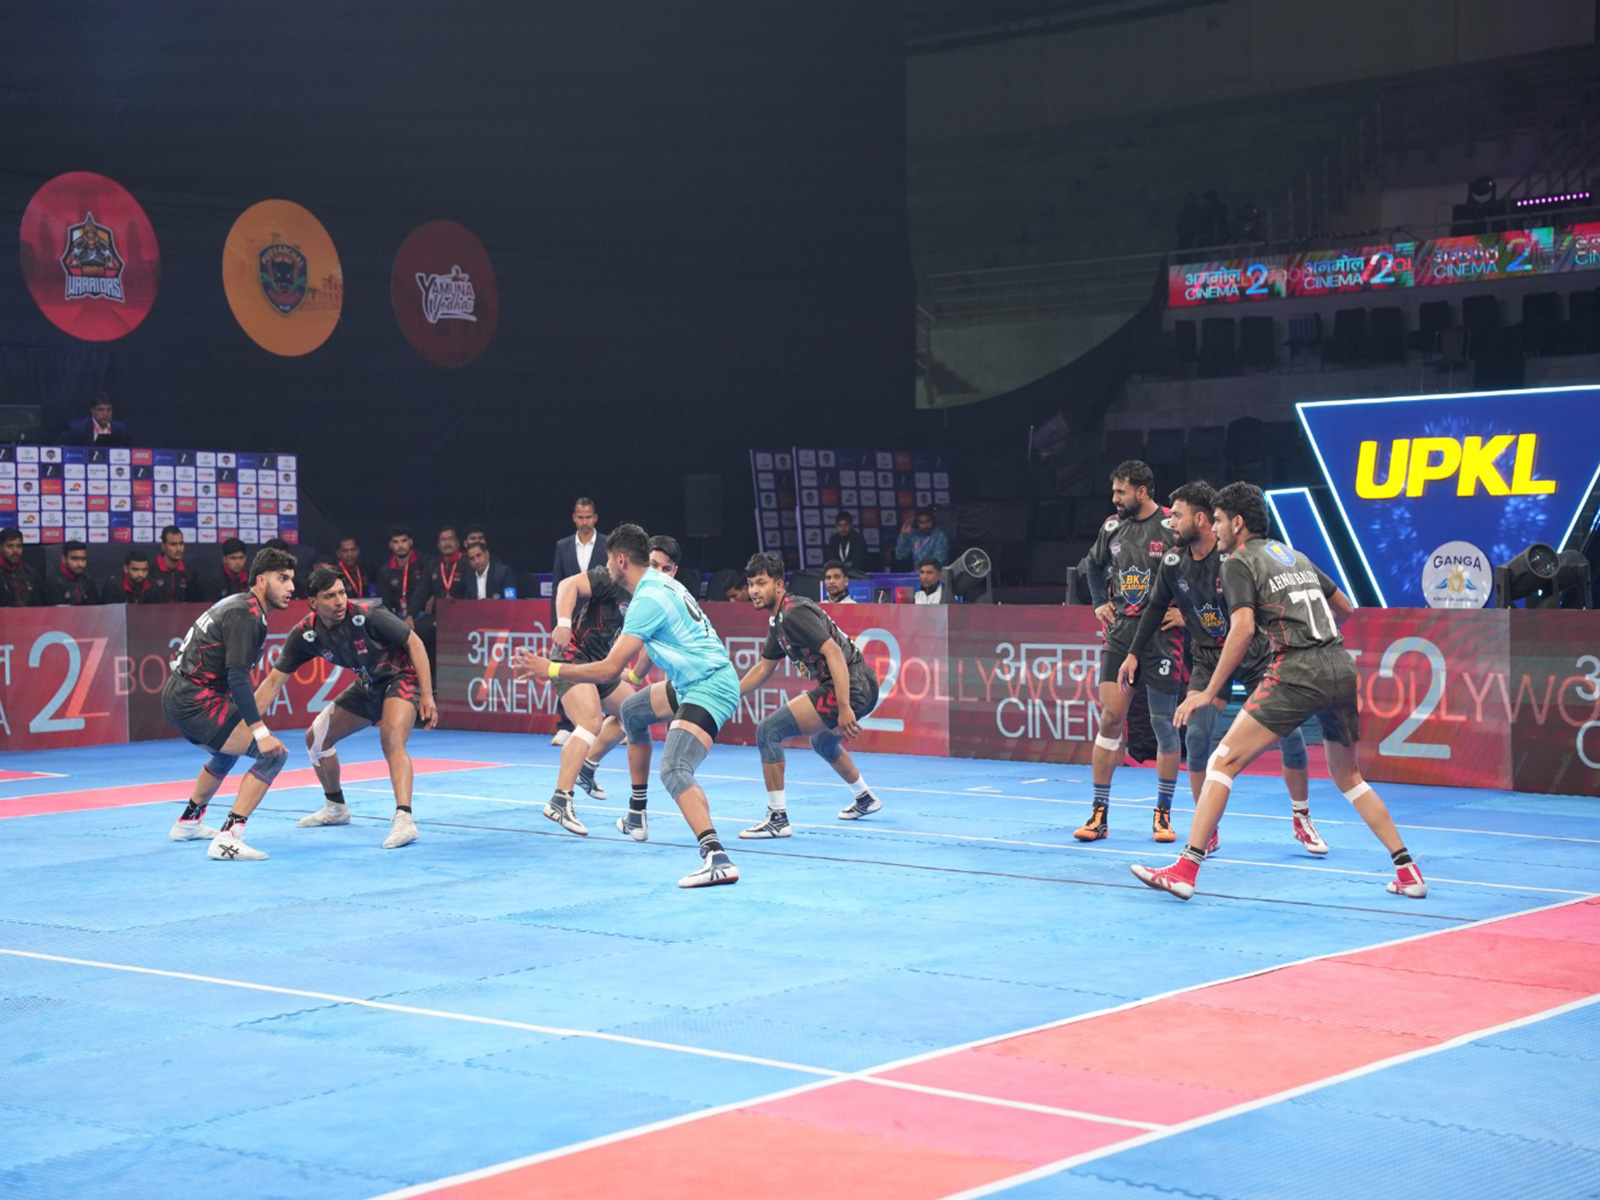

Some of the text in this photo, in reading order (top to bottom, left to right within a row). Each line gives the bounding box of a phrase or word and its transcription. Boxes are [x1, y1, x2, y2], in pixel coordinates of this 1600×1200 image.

[1304, 250, 1395, 284] अनमोल 2
[1506, 238, 1532, 272] 2
[1246, 264, 1268, 295] 2
[1304, 272, 1363, 290] CINEMA
[1434, 261, 1498, 279] CINEMA
[68, 275, 122, 298] WARRIORS
[416, 273, 475, 300] YAMUNA
[1185, 284, 1239, 300] CINEMA
[1355, 433, 1557, 499] UPKL
[1433, 555, 1482, 572] GANGA
[1126, 575, 1140, 584] BK
[1203, 612, 1217, 622] BK
[1288, 589, 1338, 640] 77
[1159, 659, 1170, 676] 3
[29, 631, 85, 734] 2
[1378, 636, 1451, 759] 2
